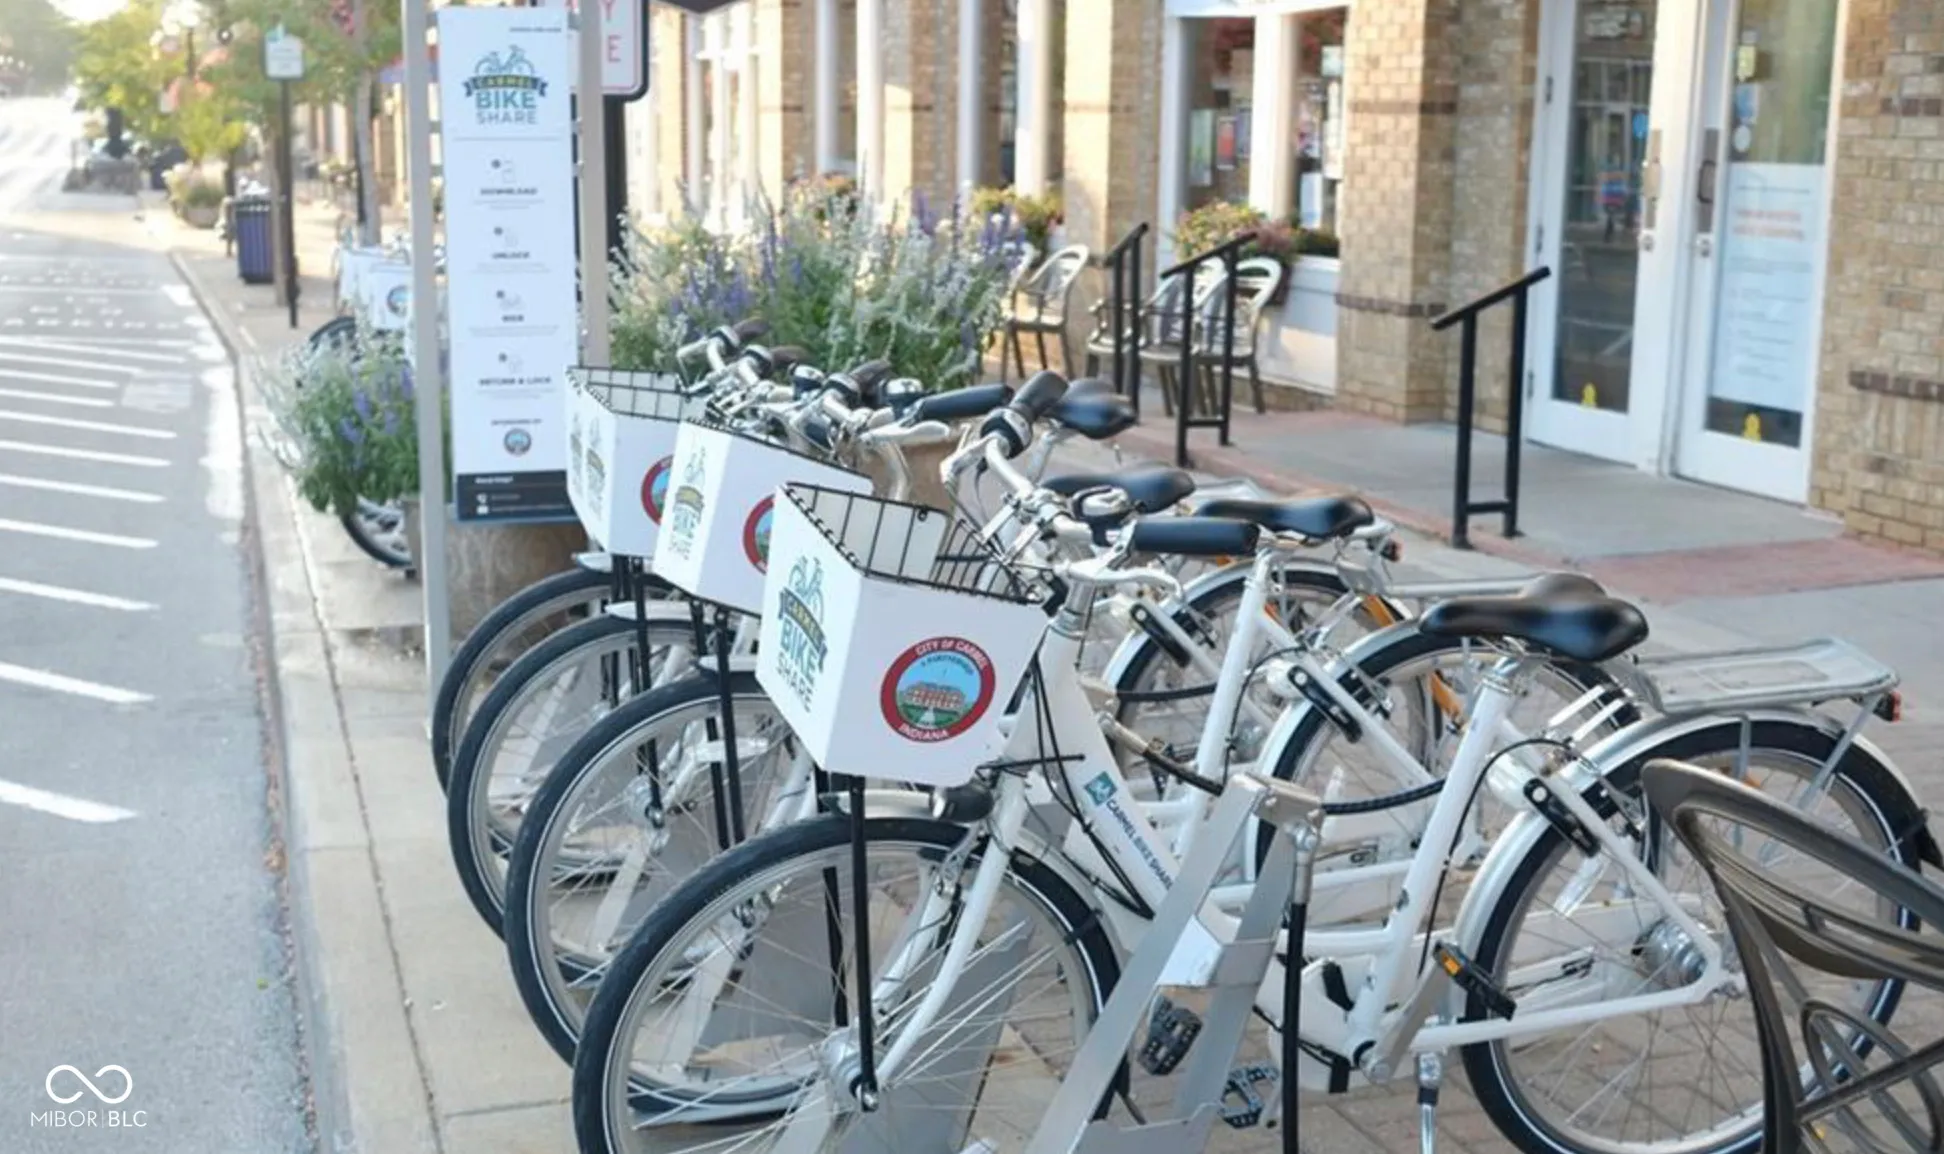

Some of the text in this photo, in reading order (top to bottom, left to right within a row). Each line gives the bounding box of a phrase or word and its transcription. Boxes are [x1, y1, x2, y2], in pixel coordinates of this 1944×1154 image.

[476, 90, 537, 109] BIKE
[477, 110, 538, 125] SHARE
[780, 616, 816, 687] BIKE
[914, 641, 939, 656] CITY
[941, 639, 955, 648] OF
[776, 651, 813, 713] SHARE
[899, 723, 949, 739] INDIANA
